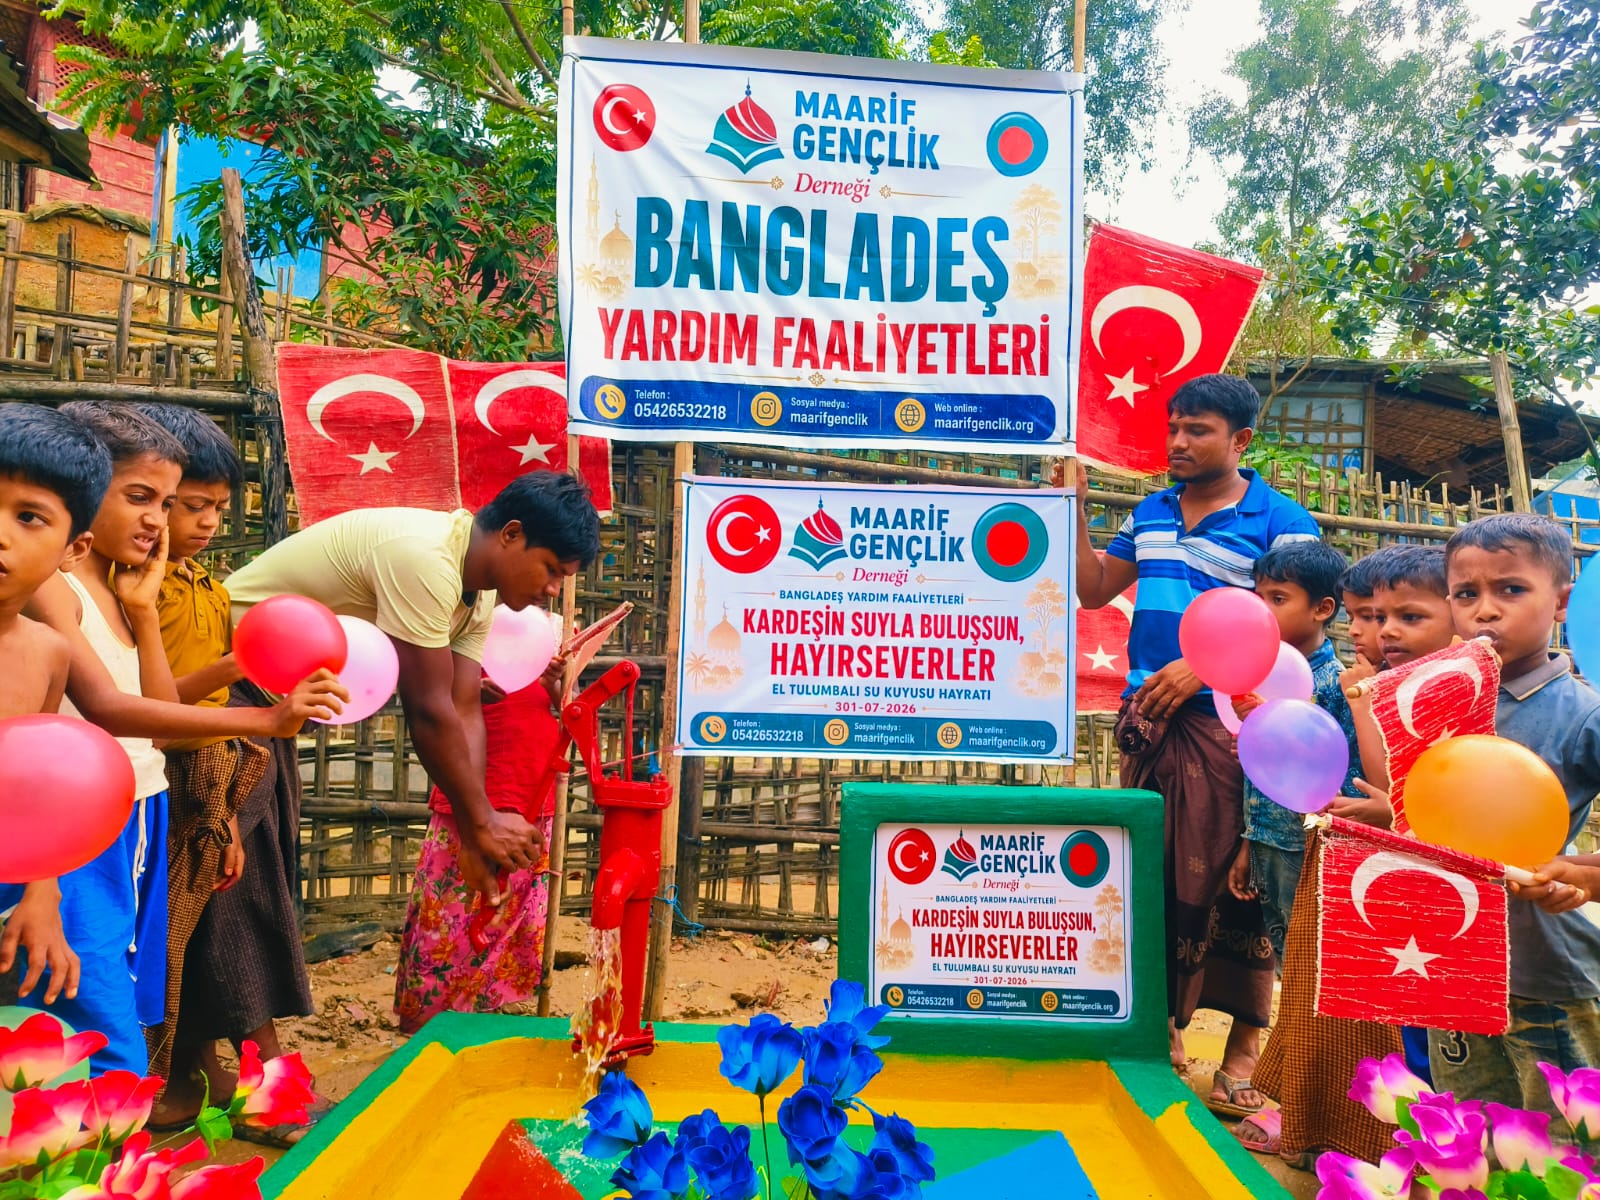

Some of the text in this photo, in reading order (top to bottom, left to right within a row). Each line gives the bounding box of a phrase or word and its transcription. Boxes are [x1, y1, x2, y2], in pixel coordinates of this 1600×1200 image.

[795, 91, 916, 123] MAARİF
[793, 124, 940, 175] GENÇLİK
[794, 173, 871, 203] Derneği
[635, 196, 1009, 318] BANGLADEŞ
[598, 307, 1050, 376] YARDIM FAALİYETLERİ
[635, 390, 665, 400] Telefon
[791, 397, 817, 408] Sosyal
[819, 399, 846, 409] medya
[634, 403, 727, 420] 05426532218
[935, 404, 951, 412] Web
[954, 404, 978, 413] online
[790, 412, 868, 427] maarifgenclik
[934, 417, 1033, 433] maarifgenclik.org
[850, 503, 950, 531] MAARİF
[850, 530, 965, 568] GENÇLİK
[852, 567, 909, 587] Derneği
[779, 590, 964, 605] BANGLADEŞ YARDIM FAALİYETLERİ
[743, 605, 1025, 647] KARDEŞİN SUYLA BULUŞSUN,
[770, 643, 995, 681] HAYIRSEVERLER
[773, 684, 991, 700] EL TULUMBALI SU KUYUSU HAYRATI
[835, 701, 916, 713] 301-07-2026
[732, 729, 804, 742] 05426532218
[854, 734, 915, 745] maarifgenclik
[969, 736, 1045, 749] maarifgenclik.org
[981, 832, 1045, 851] MAARİF
[980, 851, 1056, 878] GENÇLİK
[983, 878, 1019, 892] Derneği
[936, 895, 1056, 905] BANGLADEŞ YARDIM FAALİYETLERİ
[912, 906, 1096, 934] KARDEŞİN SUYLA BULUŞSUN,
[931, 933, 1078, 961] HAYIRSEVERLER
[933, 963, 1076, 975] EL TULUMBALI SU KUYUSU HAYRATI
[974, 976, 1027, 985] 301-07-2026
[907, 996, 954, 1006] 05426532218
